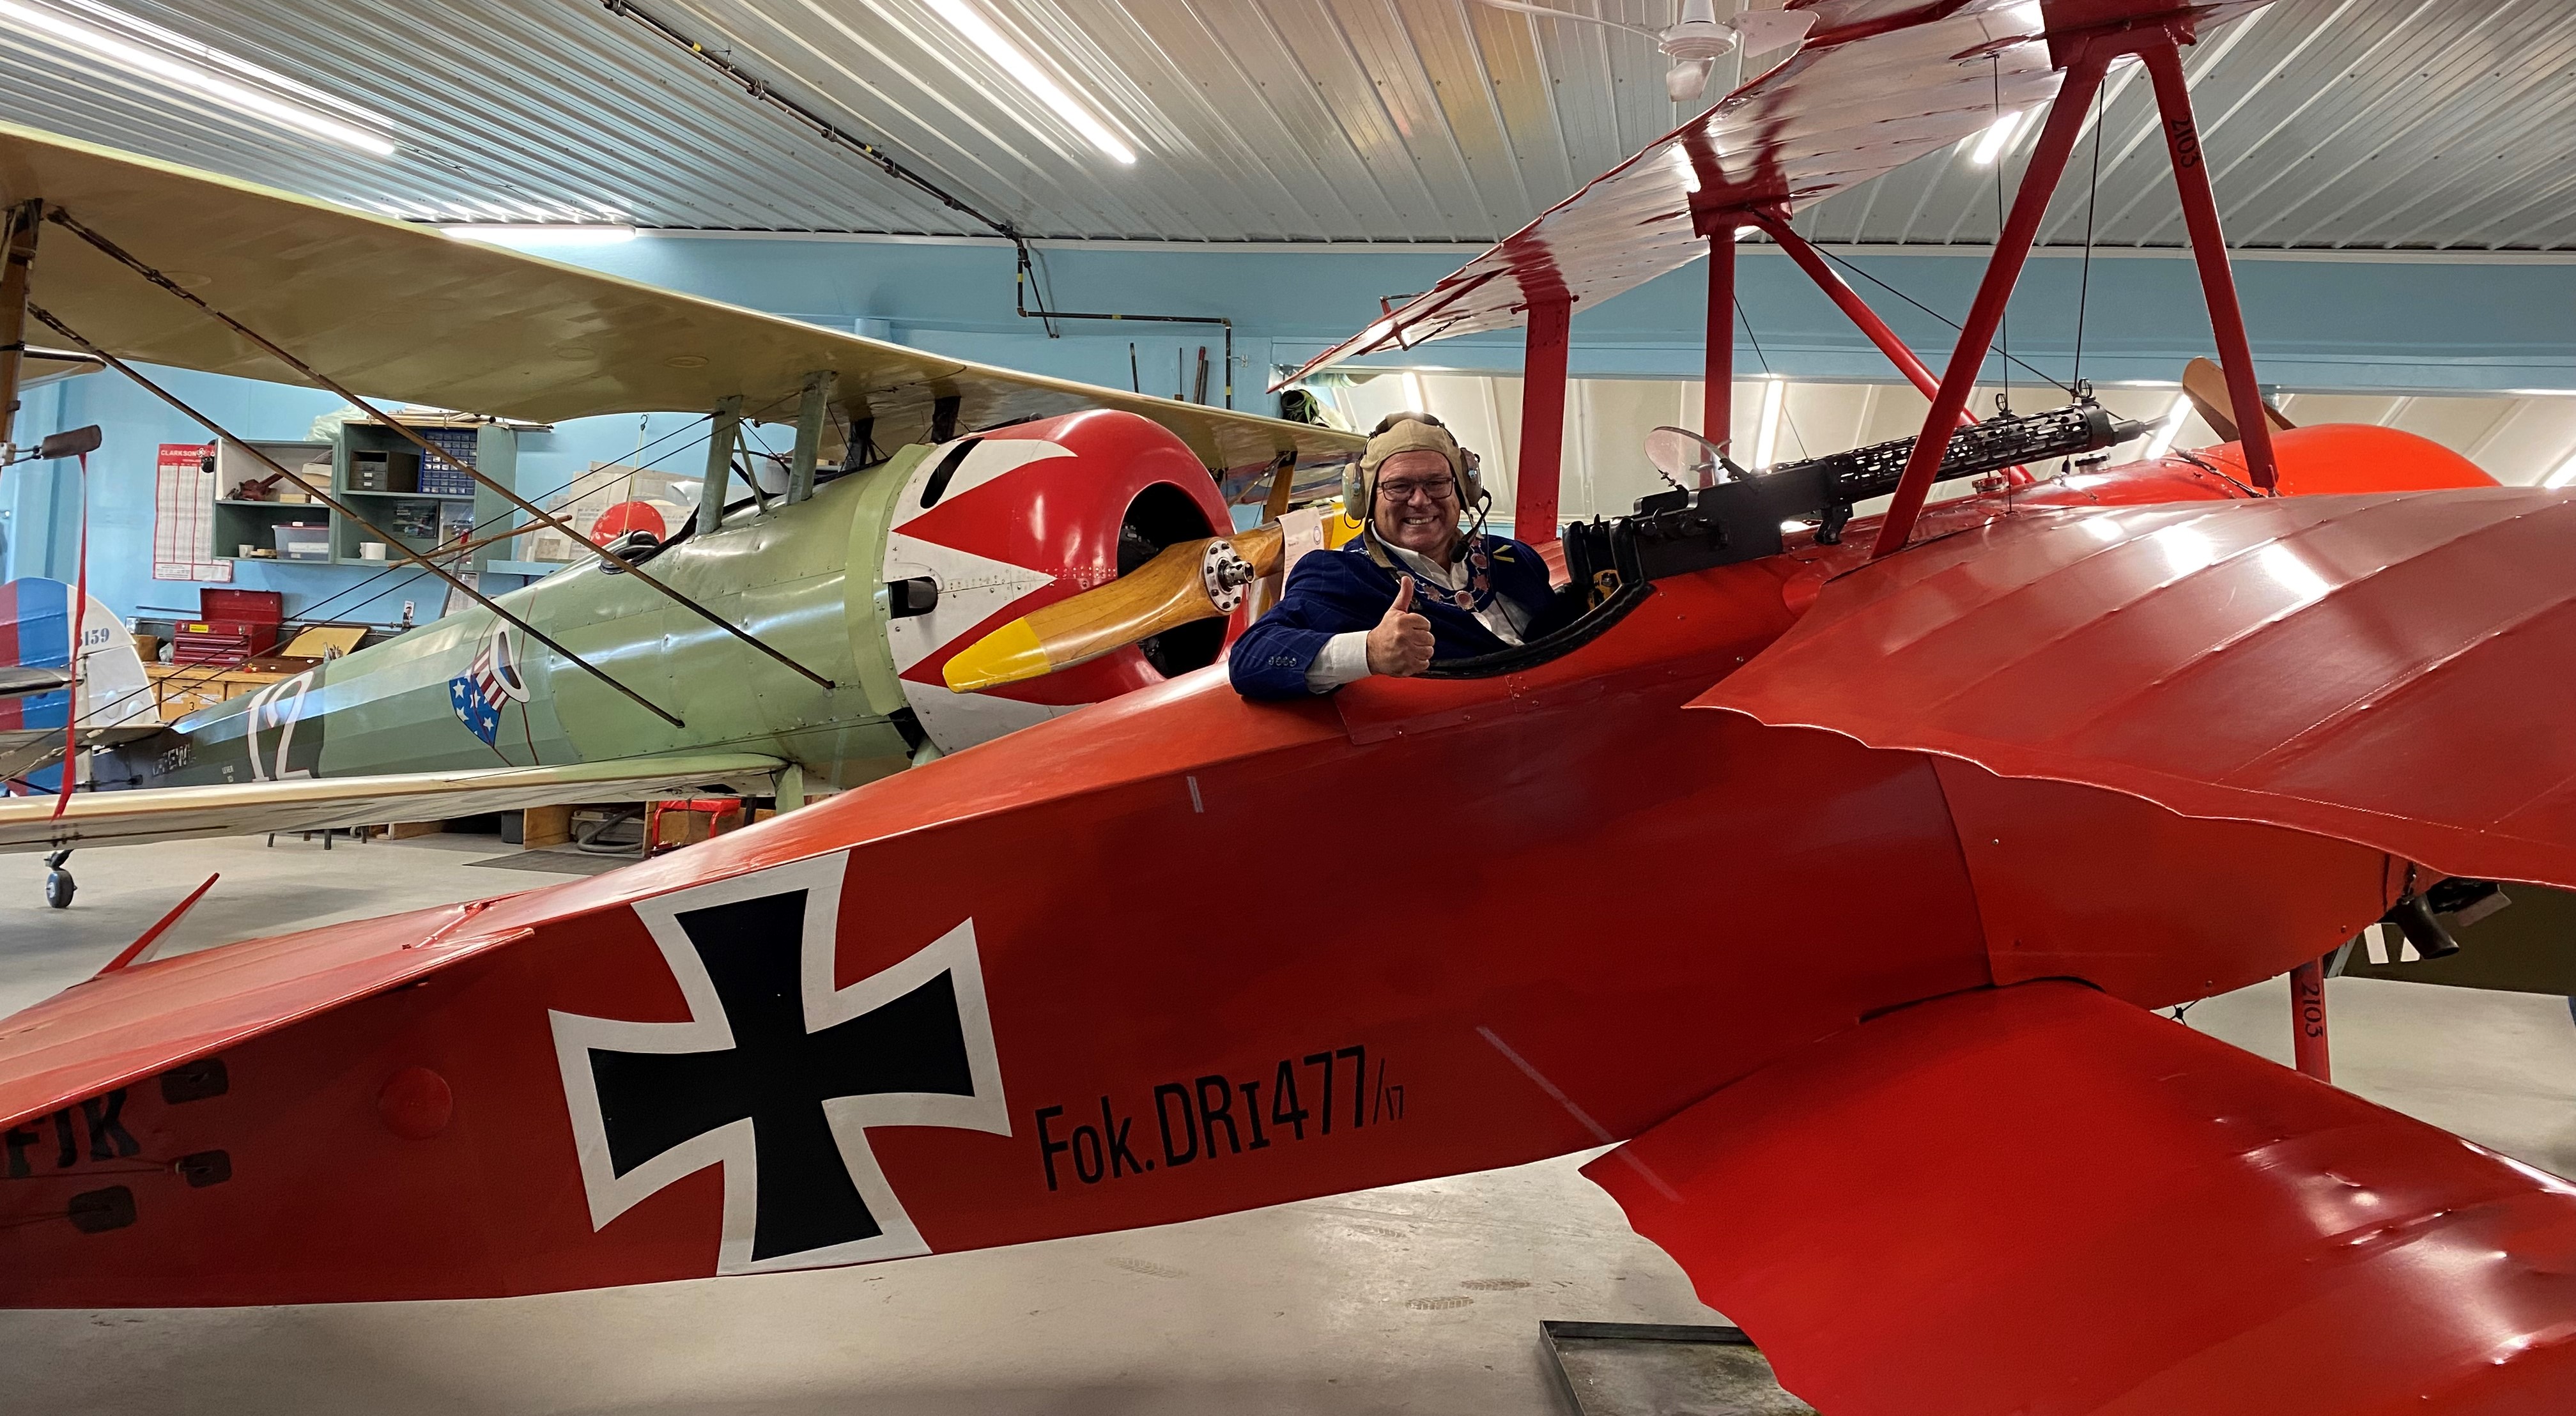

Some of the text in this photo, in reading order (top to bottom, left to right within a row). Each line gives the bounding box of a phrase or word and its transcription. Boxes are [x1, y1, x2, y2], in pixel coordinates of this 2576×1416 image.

[2171, 111, 2202, 168] 2103
[78, 627, 110, 647] 159
[189, 701, 195, 711] 3
[247, 671, 314, 783] 12
[2302, 981, 2324, 1038] 2103
